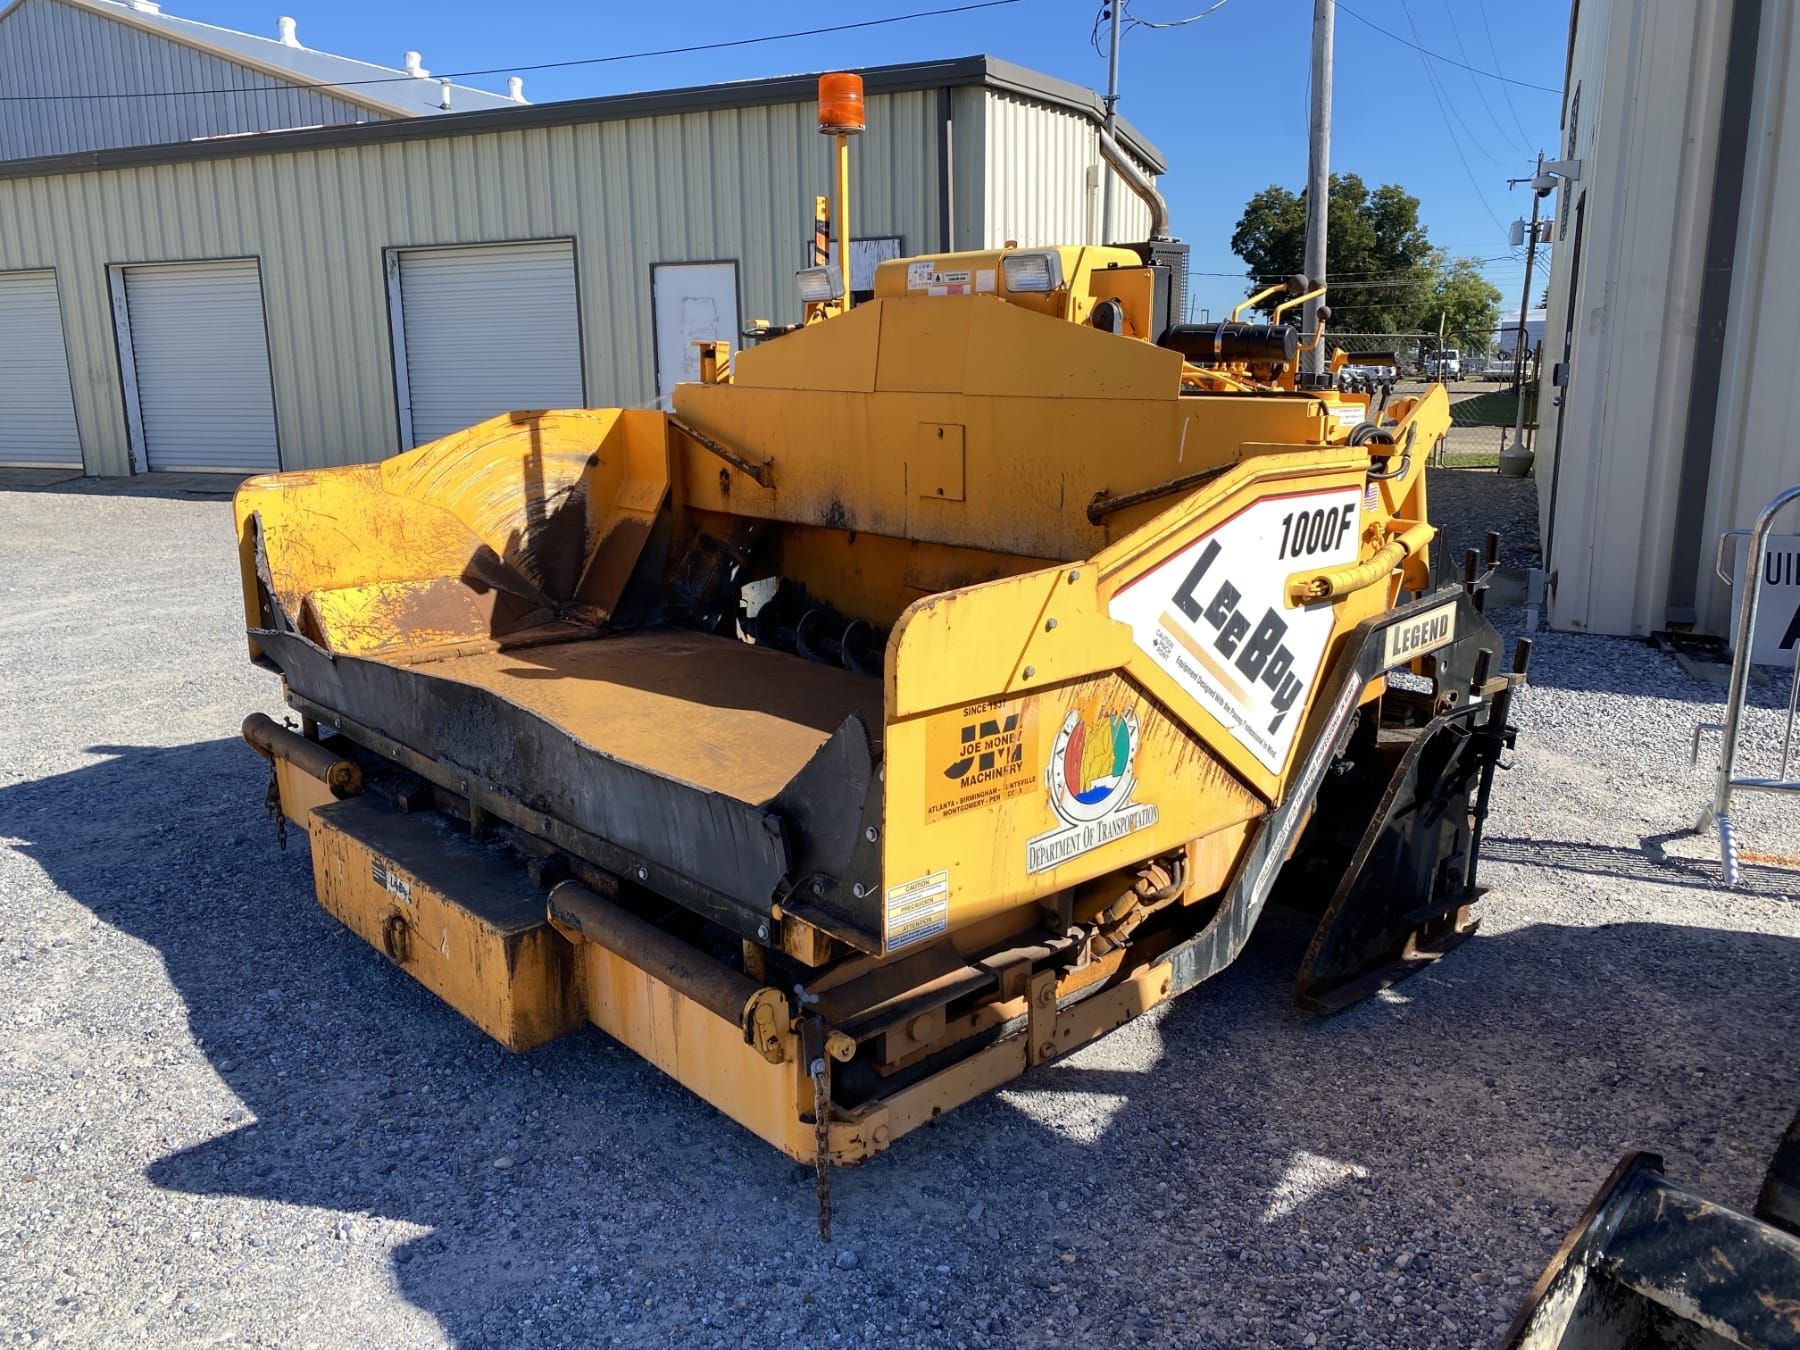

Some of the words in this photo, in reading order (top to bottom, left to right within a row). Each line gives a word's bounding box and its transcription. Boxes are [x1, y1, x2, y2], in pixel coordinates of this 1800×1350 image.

[1278, 503, 1356, 560] 1000F
[1176, 656, 1199, 683] Equipment
[1198, 676, 1218, 698] Designed
[1230, 708, 1243, 725] Paving
[963, 703, 987, 717] SINCE
[960, 742, 981, 757] JOE
[960, 762, 1023, 789] MACHINERY
[928, 800, 956, 814] ATLANTA
[959, 788, 998, 803] BIRMINGHAM
[943, 799, 985, 817] MONTGOMERY
[1029, 832, 1081, 870] DEPARTMENT
[905, 879, 930, 892] CAUTION
[902, 917, 932, 932] ATTENTION
